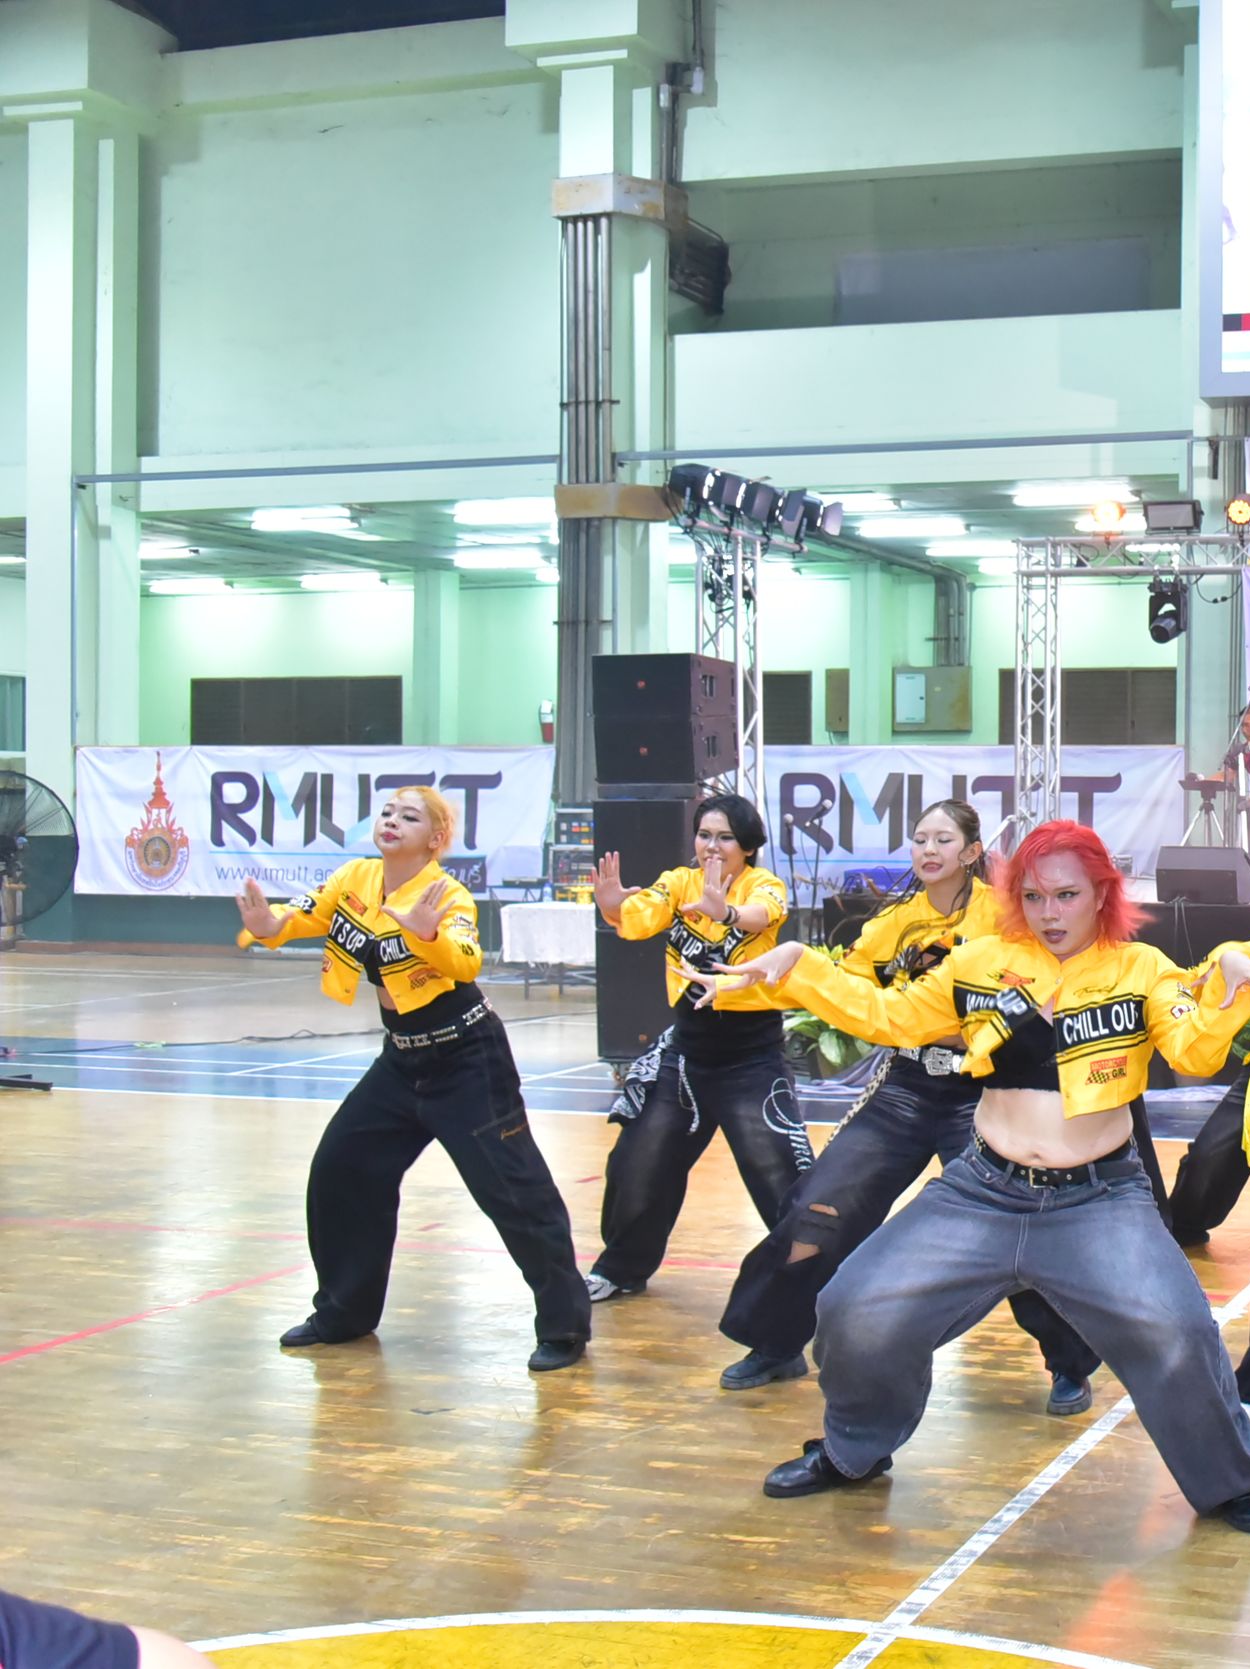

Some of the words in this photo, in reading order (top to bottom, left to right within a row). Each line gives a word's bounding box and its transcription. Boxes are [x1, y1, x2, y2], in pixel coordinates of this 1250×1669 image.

[346, 929, 367, 952] UP
[681, 936, 703, 958] UP
[1062, 1007, 1110, 1045] CHILL
[1111, 1001, 1138, 1032] OU
